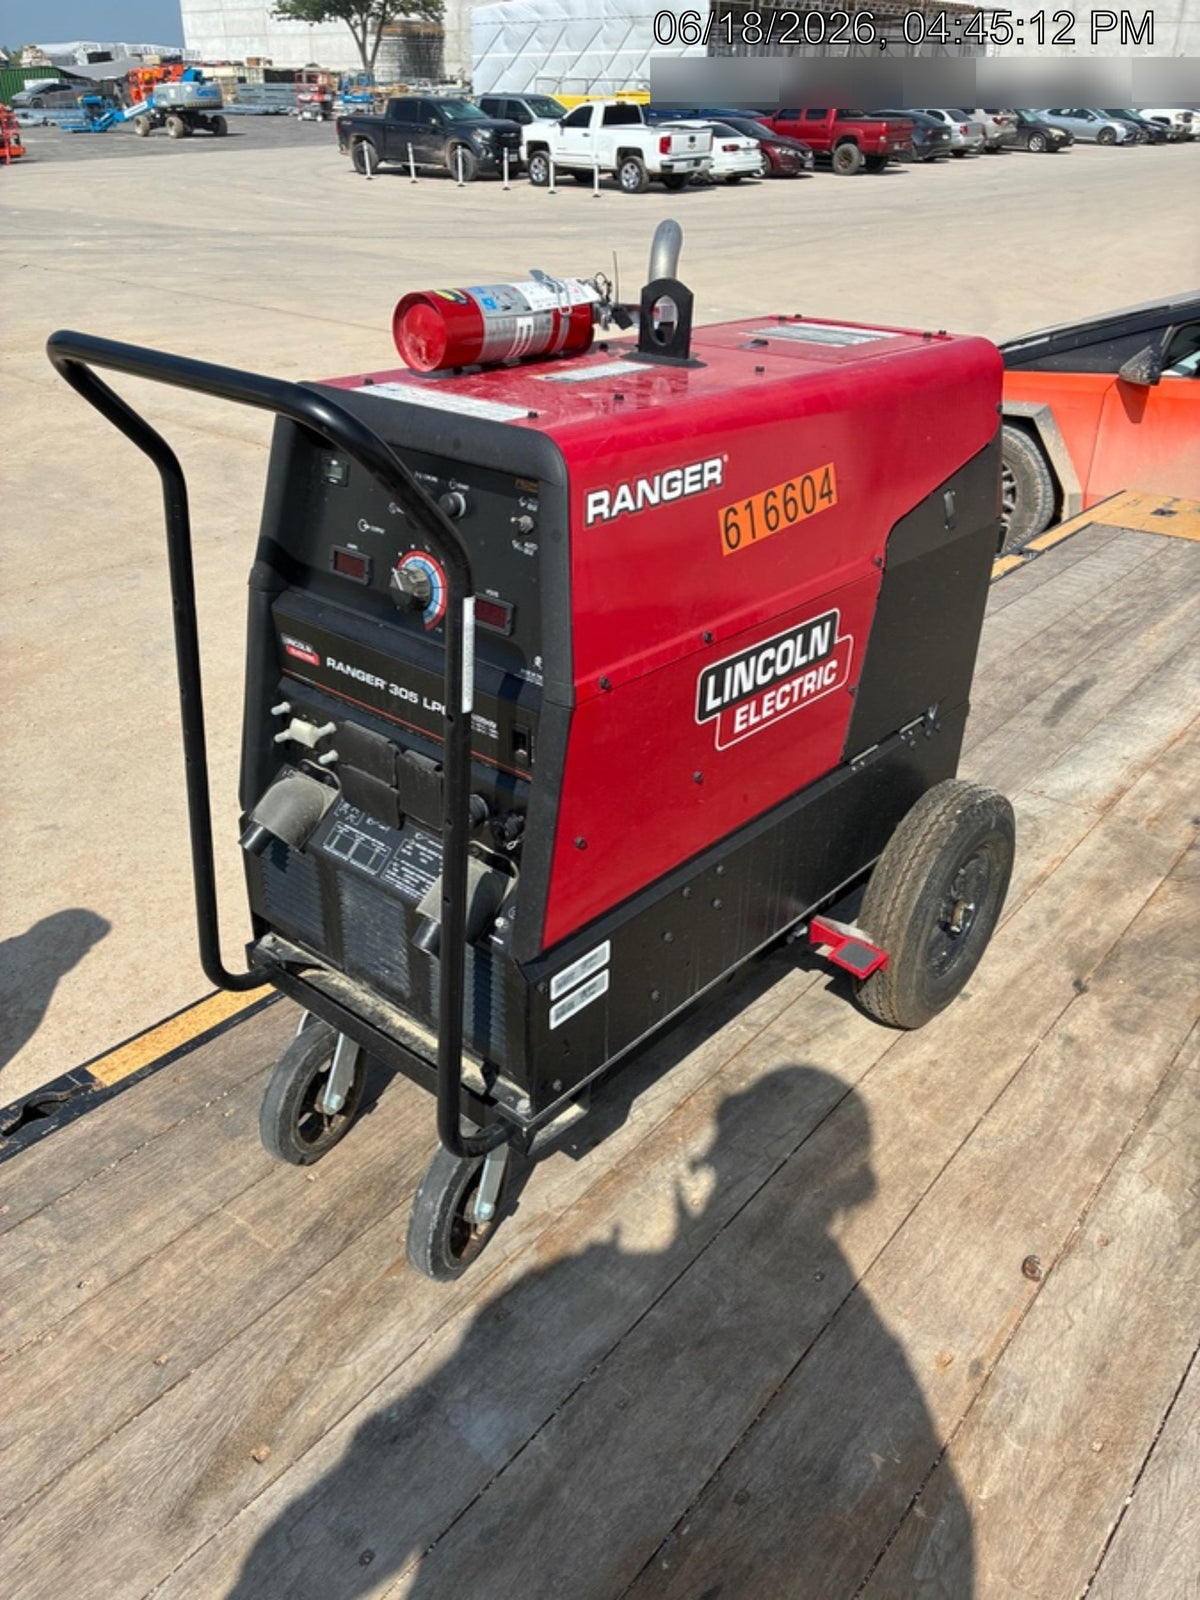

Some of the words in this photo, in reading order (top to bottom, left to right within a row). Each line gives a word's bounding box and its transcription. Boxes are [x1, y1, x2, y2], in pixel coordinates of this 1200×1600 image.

[586, 457, 723, 525] RANGER
[723, 466, 834, 551] 616604
[325, 656, 388, 691] RANGER
[388, 682, 420, 705] 305
[705, 621, 832, 712] LINCOLN
[733, 659, 838, 734] ELECTRIC
